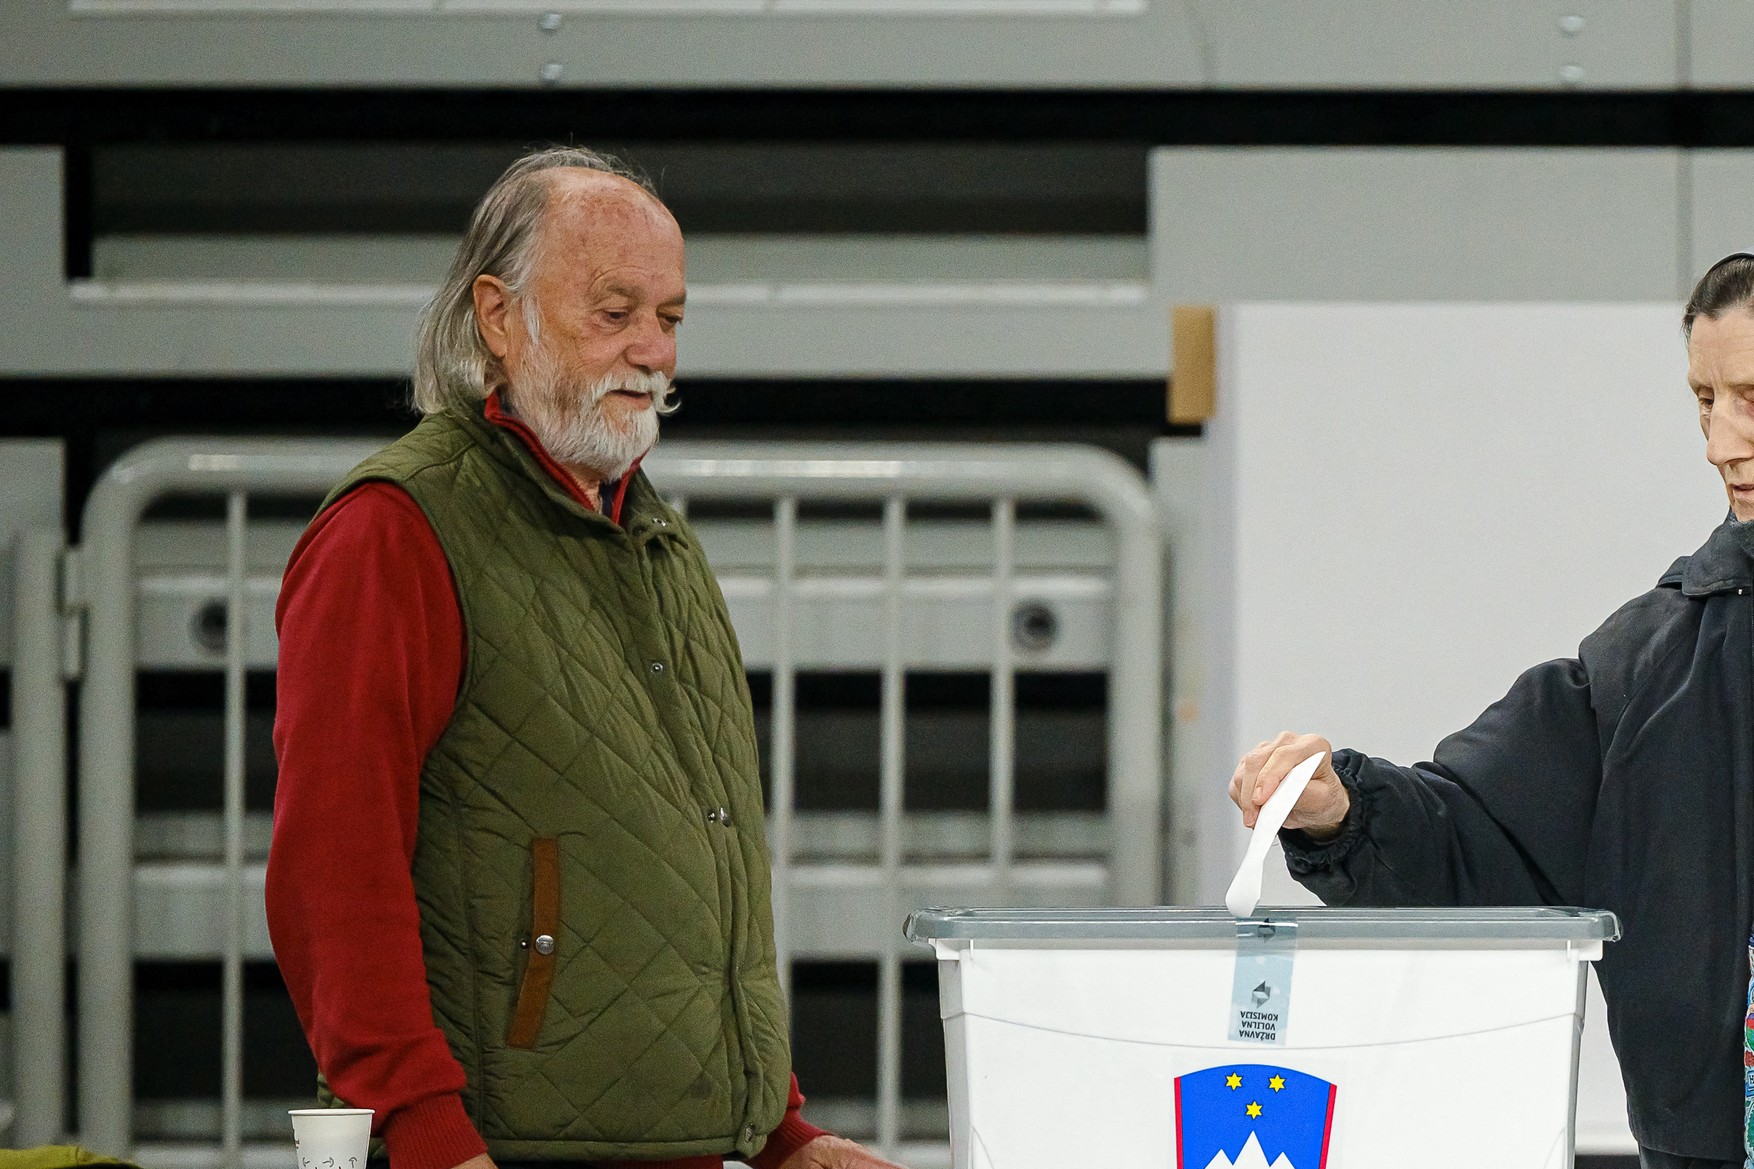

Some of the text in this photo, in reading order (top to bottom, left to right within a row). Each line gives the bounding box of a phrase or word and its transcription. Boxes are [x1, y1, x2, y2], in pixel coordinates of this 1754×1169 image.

[1240, 1010, 1279, 1021] KOMISIJA
[1241, 1020, 1276, 1031] VOLILNA
[1239, 1029, 1276, 1041] DRŽAVNA
